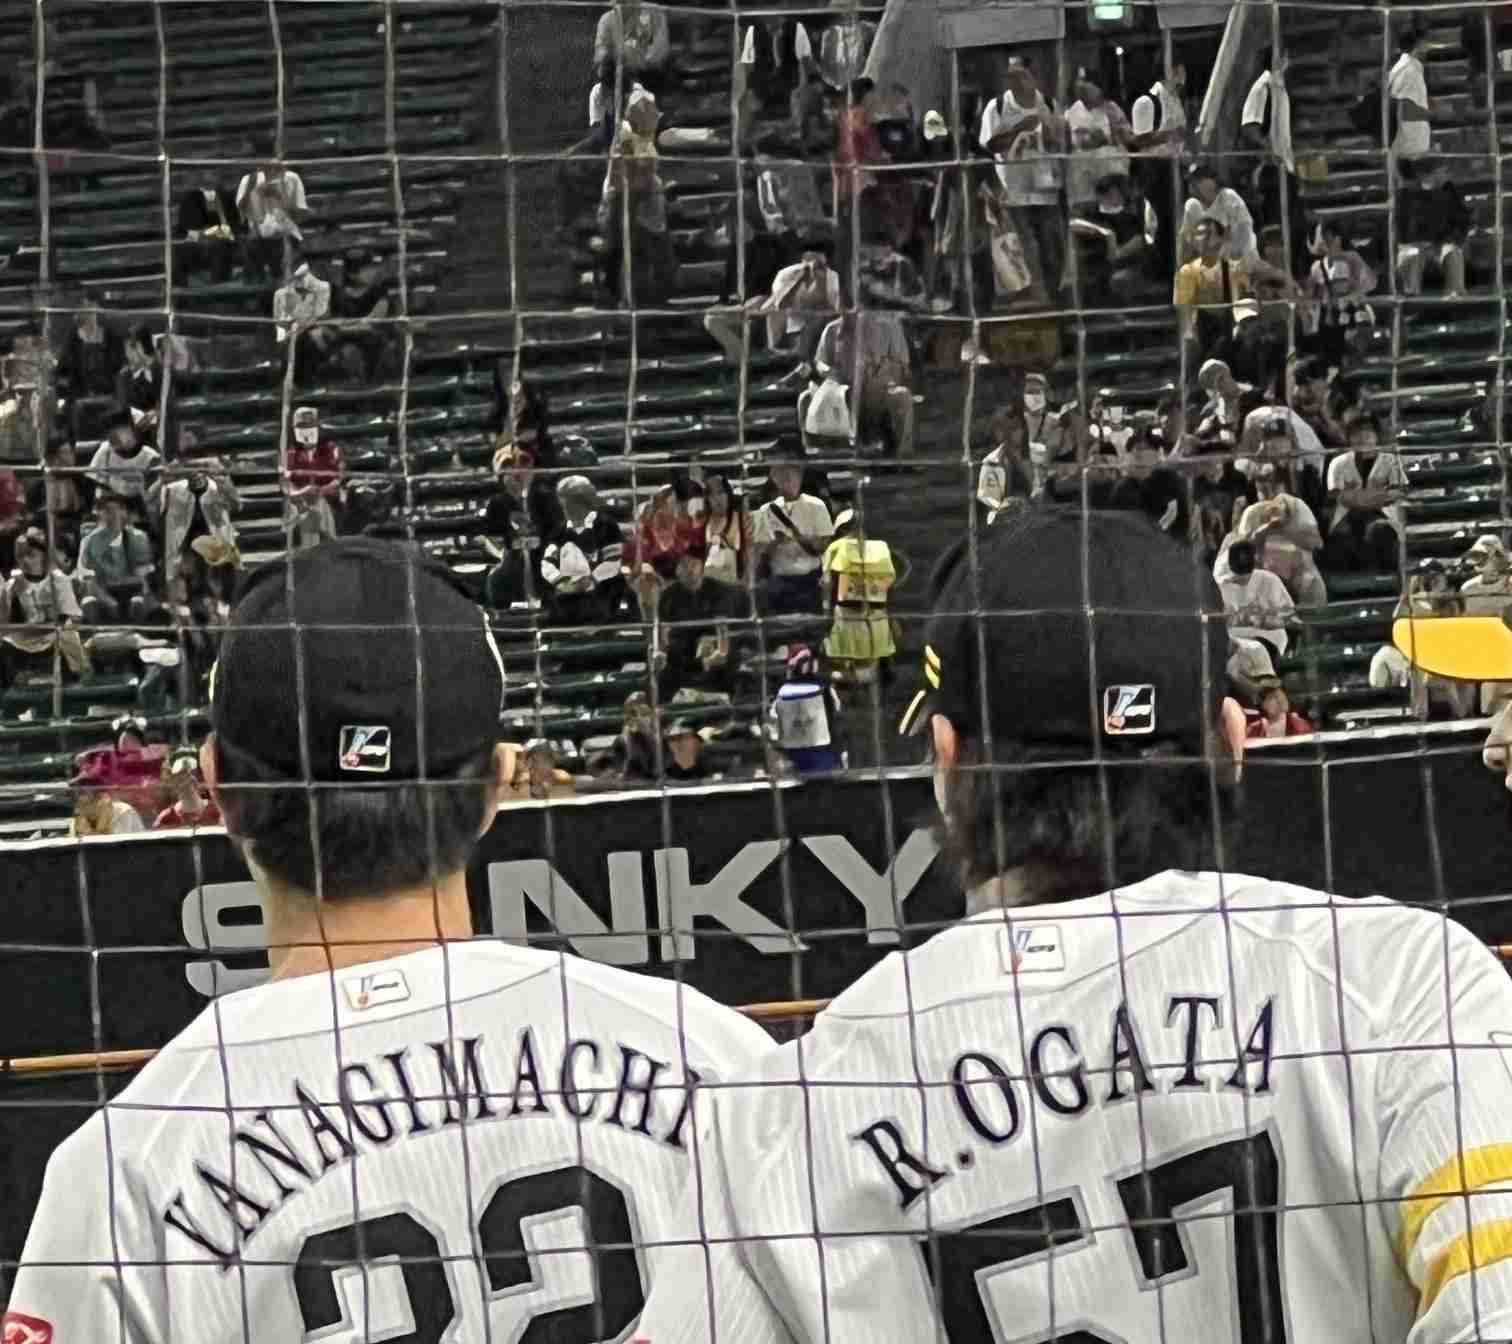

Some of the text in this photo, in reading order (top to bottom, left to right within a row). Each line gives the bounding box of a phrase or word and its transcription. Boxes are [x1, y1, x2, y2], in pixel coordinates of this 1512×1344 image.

[181, 829, 941, 998] SNKY
[163, 1025, 701, 1272] YANAGIMACHI
[855, 992, 1279, 1209] R.OGATA
